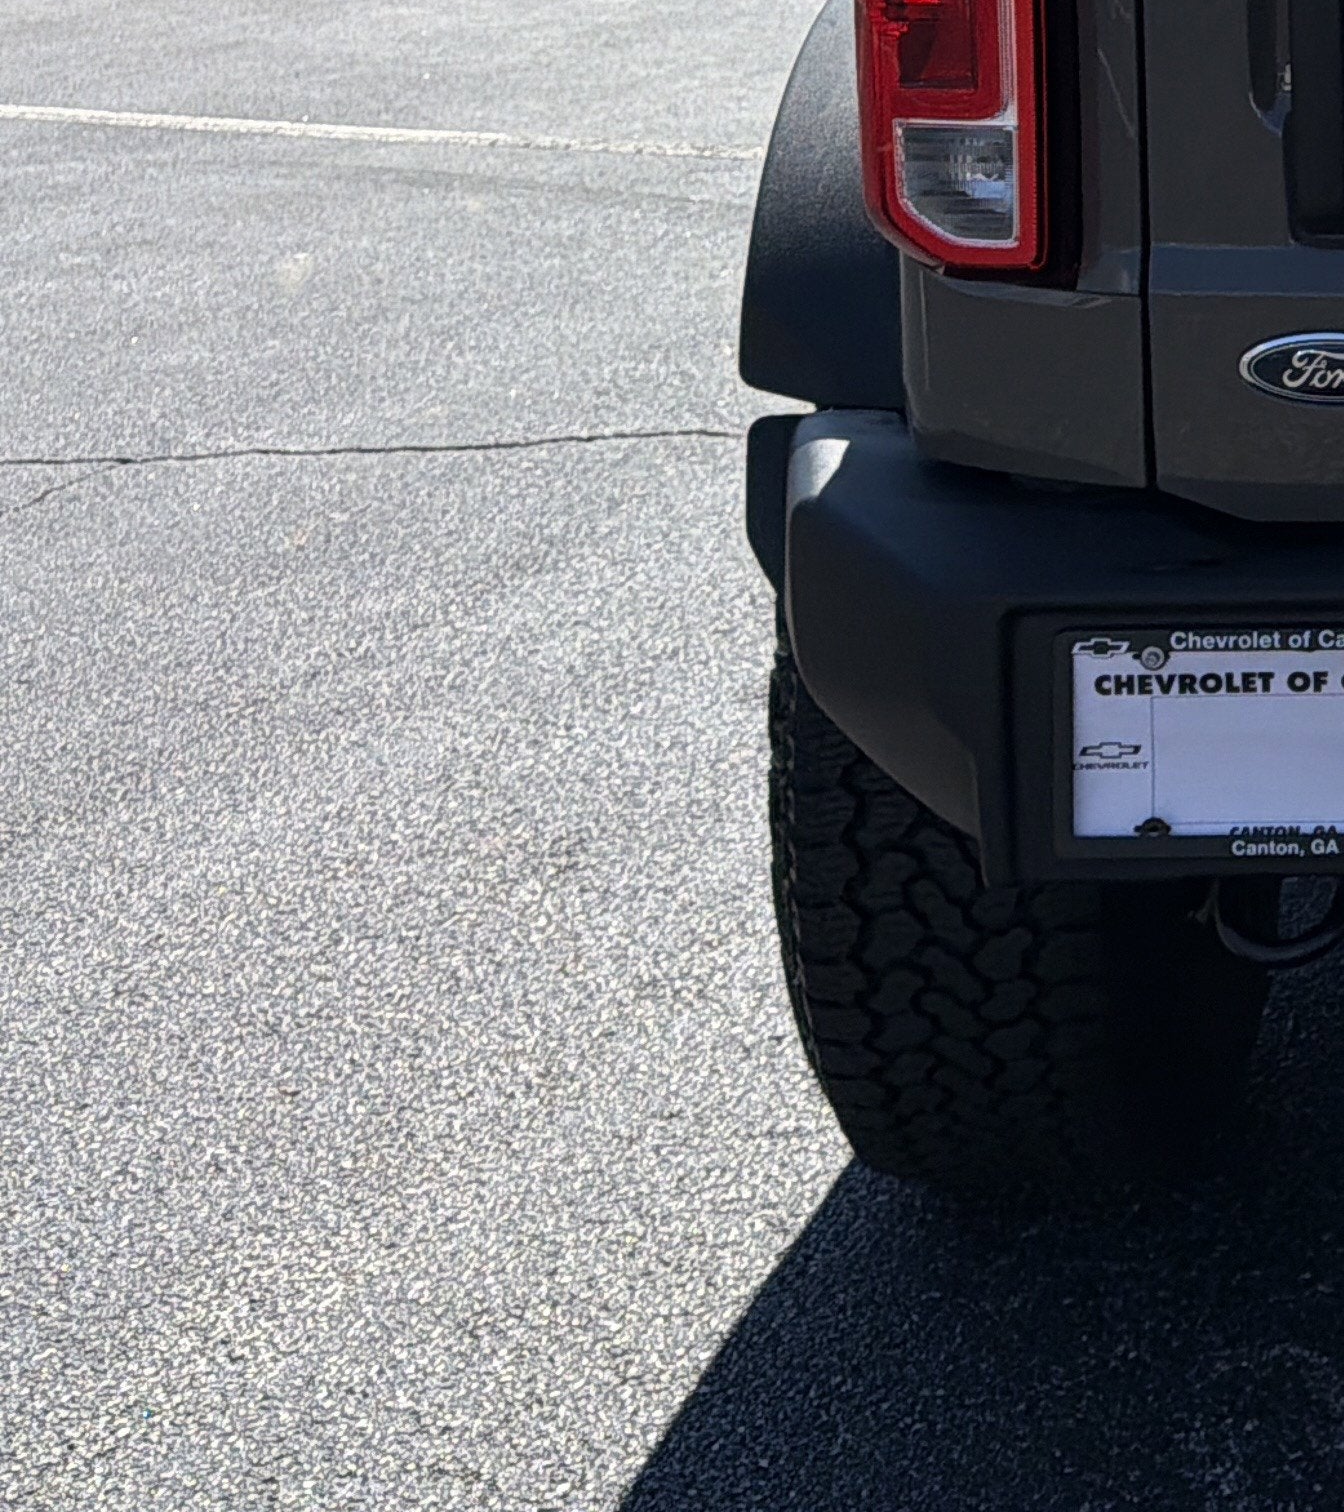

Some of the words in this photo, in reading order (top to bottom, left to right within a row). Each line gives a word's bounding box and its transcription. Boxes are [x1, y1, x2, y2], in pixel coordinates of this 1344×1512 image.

[1170, 631, 1281, 650] Chevrolet
[1288, 630, 1311, 648] of
[1094, 672, 1274, 695] CHEVROLET
[1287, 671, 1328, 693] OF
[1231, 839, 1306, 857] Canton,
[1310, 838, 1340, 855] GA
